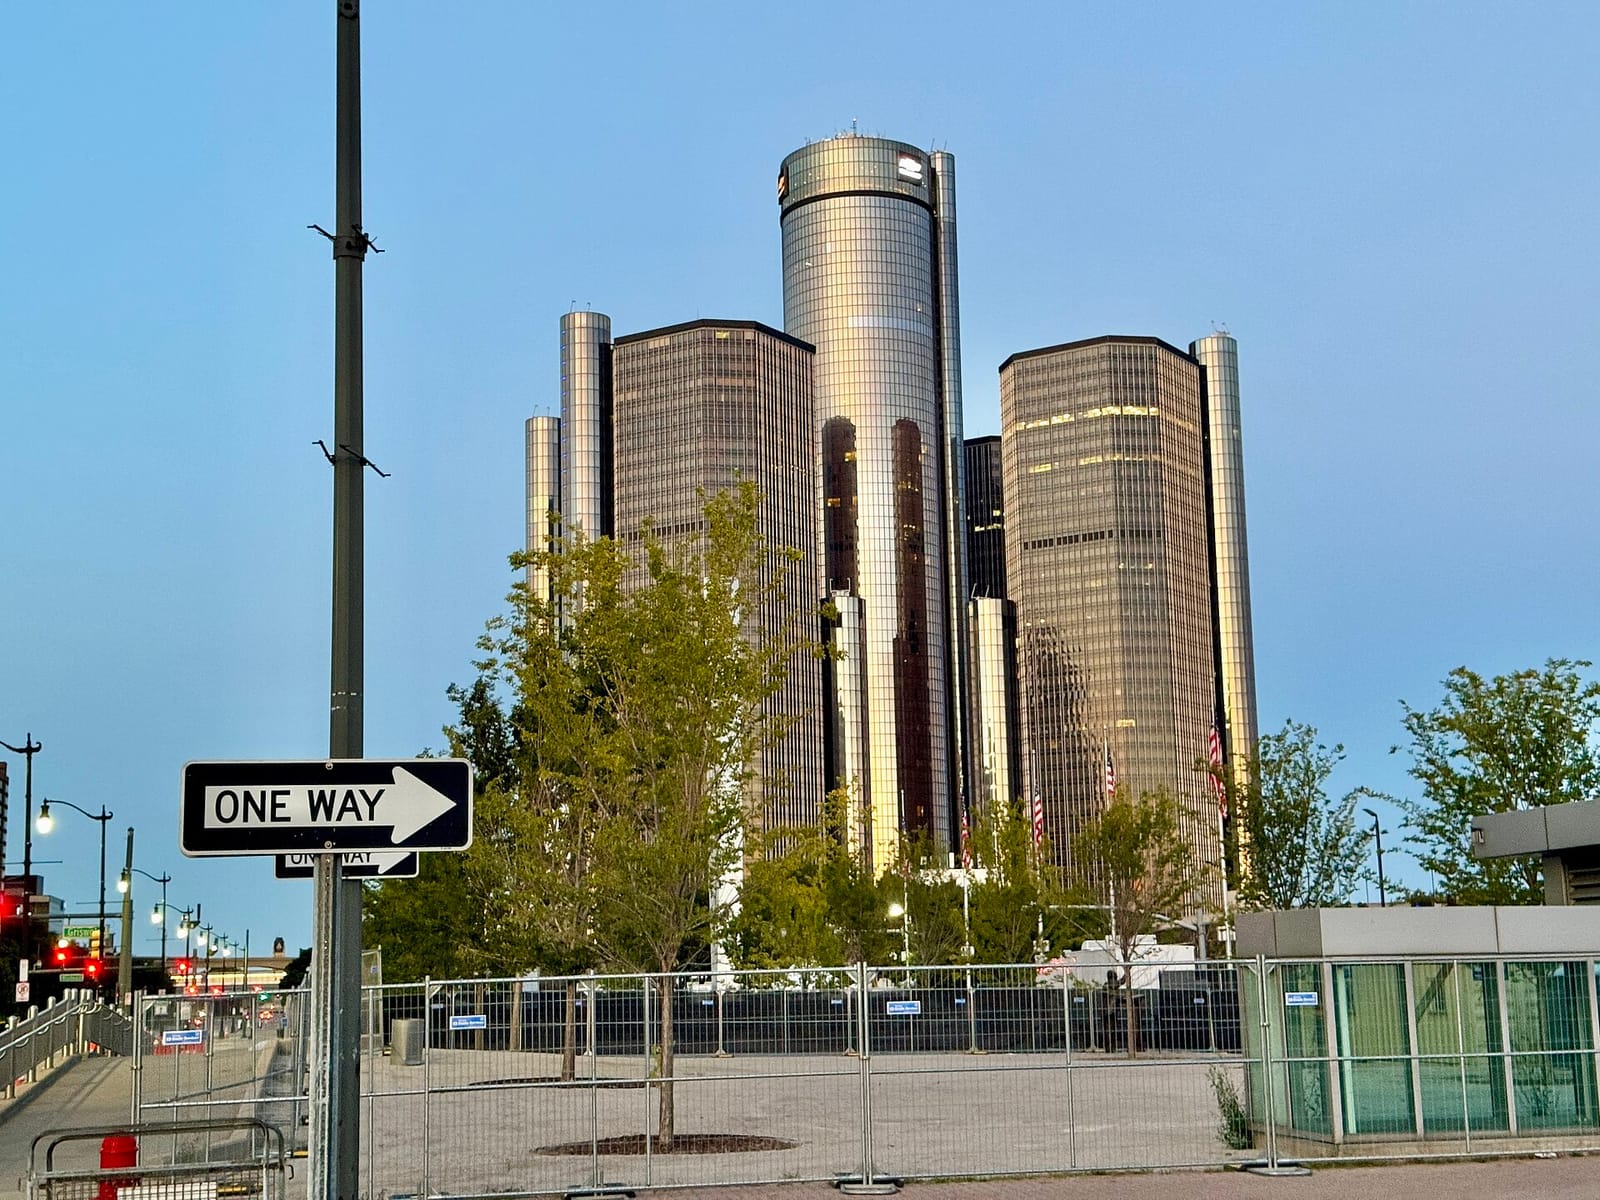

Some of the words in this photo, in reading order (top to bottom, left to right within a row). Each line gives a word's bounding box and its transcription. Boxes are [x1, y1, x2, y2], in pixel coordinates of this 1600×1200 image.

[215, 789, 291, 823] ONE
[308, 788, 386, 822] WAY
[291, 853, 315, 865] ON
[67, 927, 97, 937] Griswo
